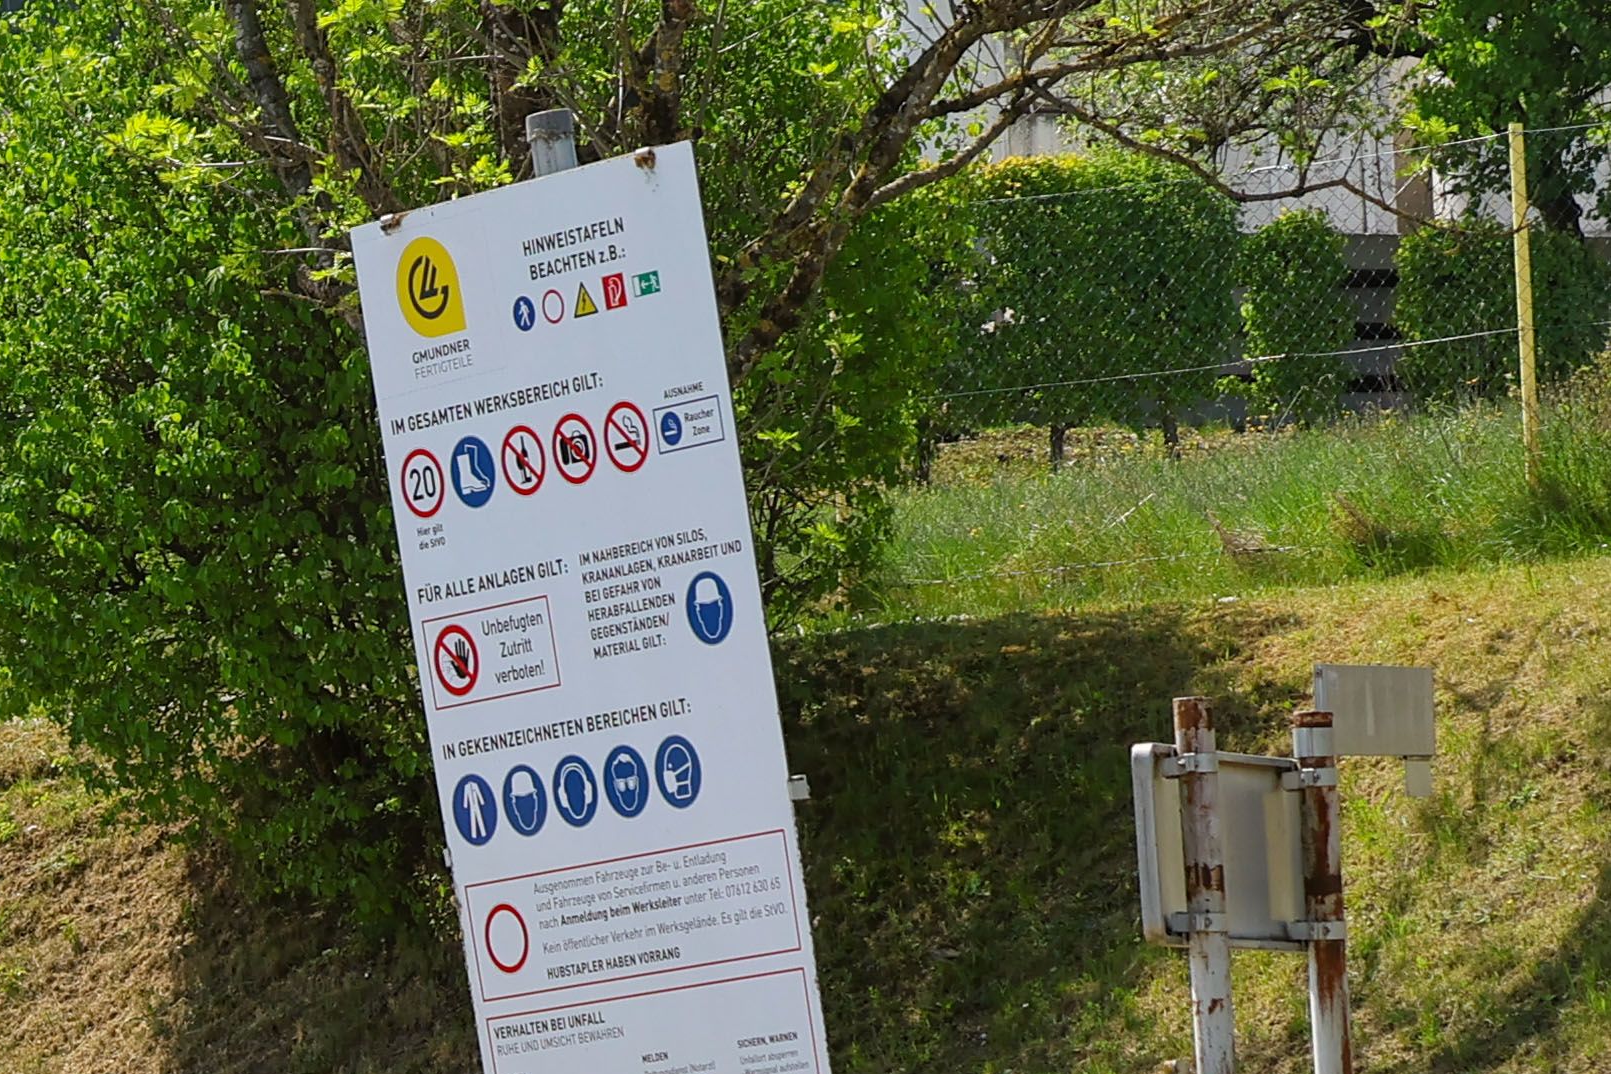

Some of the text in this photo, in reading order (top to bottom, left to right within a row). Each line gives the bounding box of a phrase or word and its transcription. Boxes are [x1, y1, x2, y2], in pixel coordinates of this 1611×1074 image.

[521, 216, 624, 257] HINWEISTAFELN
[528, 244, 626, 281] BEACHTEN z.B.:
[411, 338, 470, 364] GMUNDNER
[413, 353, 474, 380] FERTIGTEILE
[390, 371, 603, 436] IM GESAMTEN WERKSBEREICH GILT:
[663, 380, 704, 399] AUSNAHME
[683, 408, 714, 423] Raucher
[691, 425, 711, 436] Zone
[409, 464, 436, 501] 20
[416, 523, 444, 537] Hier gilt
[578, 527, 708, 566] IM NAHBEREICH VON SILOS,
[581, 539, 742, 585] KRANANLAGEN, KRANARBEIT UND
[416, 558, 569, 605] FÜR ALLE ANLAGEN GILT:
[584, 575, 662, 604] BEI GEFAHR VON
[587, 592, 676, 622] HERABFALLENDEN
[480, 612, 544, 637] Unbefugten
[590, 611, 670, 641] GEGENSTÄNDEN/
[498, 637, 533, 658] Zutritt
[592, 633, 667, 659] MATERIAL GILT:
[494, 658, 545, 684] verboten!
[441, 697, 692, 760] IN GEKENNZEICHNETEN BEREICHEN GILT:
[533, 851, 727, 896] Ausgenommen Fahrzeuge zur Be- u. Entladung
[535, 864, 760, 913] und Fahrzeuge von Servicefirmen u. anderen Personen
[538, 876, 781, 929] nach Anmeldung beim Werksleiter unter Tel: 07612 630 65
[541, 901, 788, 955] Kein öffentlicher Verkehr im Werksgelände. Es gilt die StVO.
[546, 946, 681, 980] HUBSTAPLER HABEN VORRANG
[492, 1010, 606, 1040] VERHALTEN BEI UNFALL
[736, 1031, 798, 1049] SICHERN, WARNEN
[496, 1025, 625, 1056] RUHE UND UMSICHT BEWAHREN
[641, 1051, 669, 1063] MELDEN
